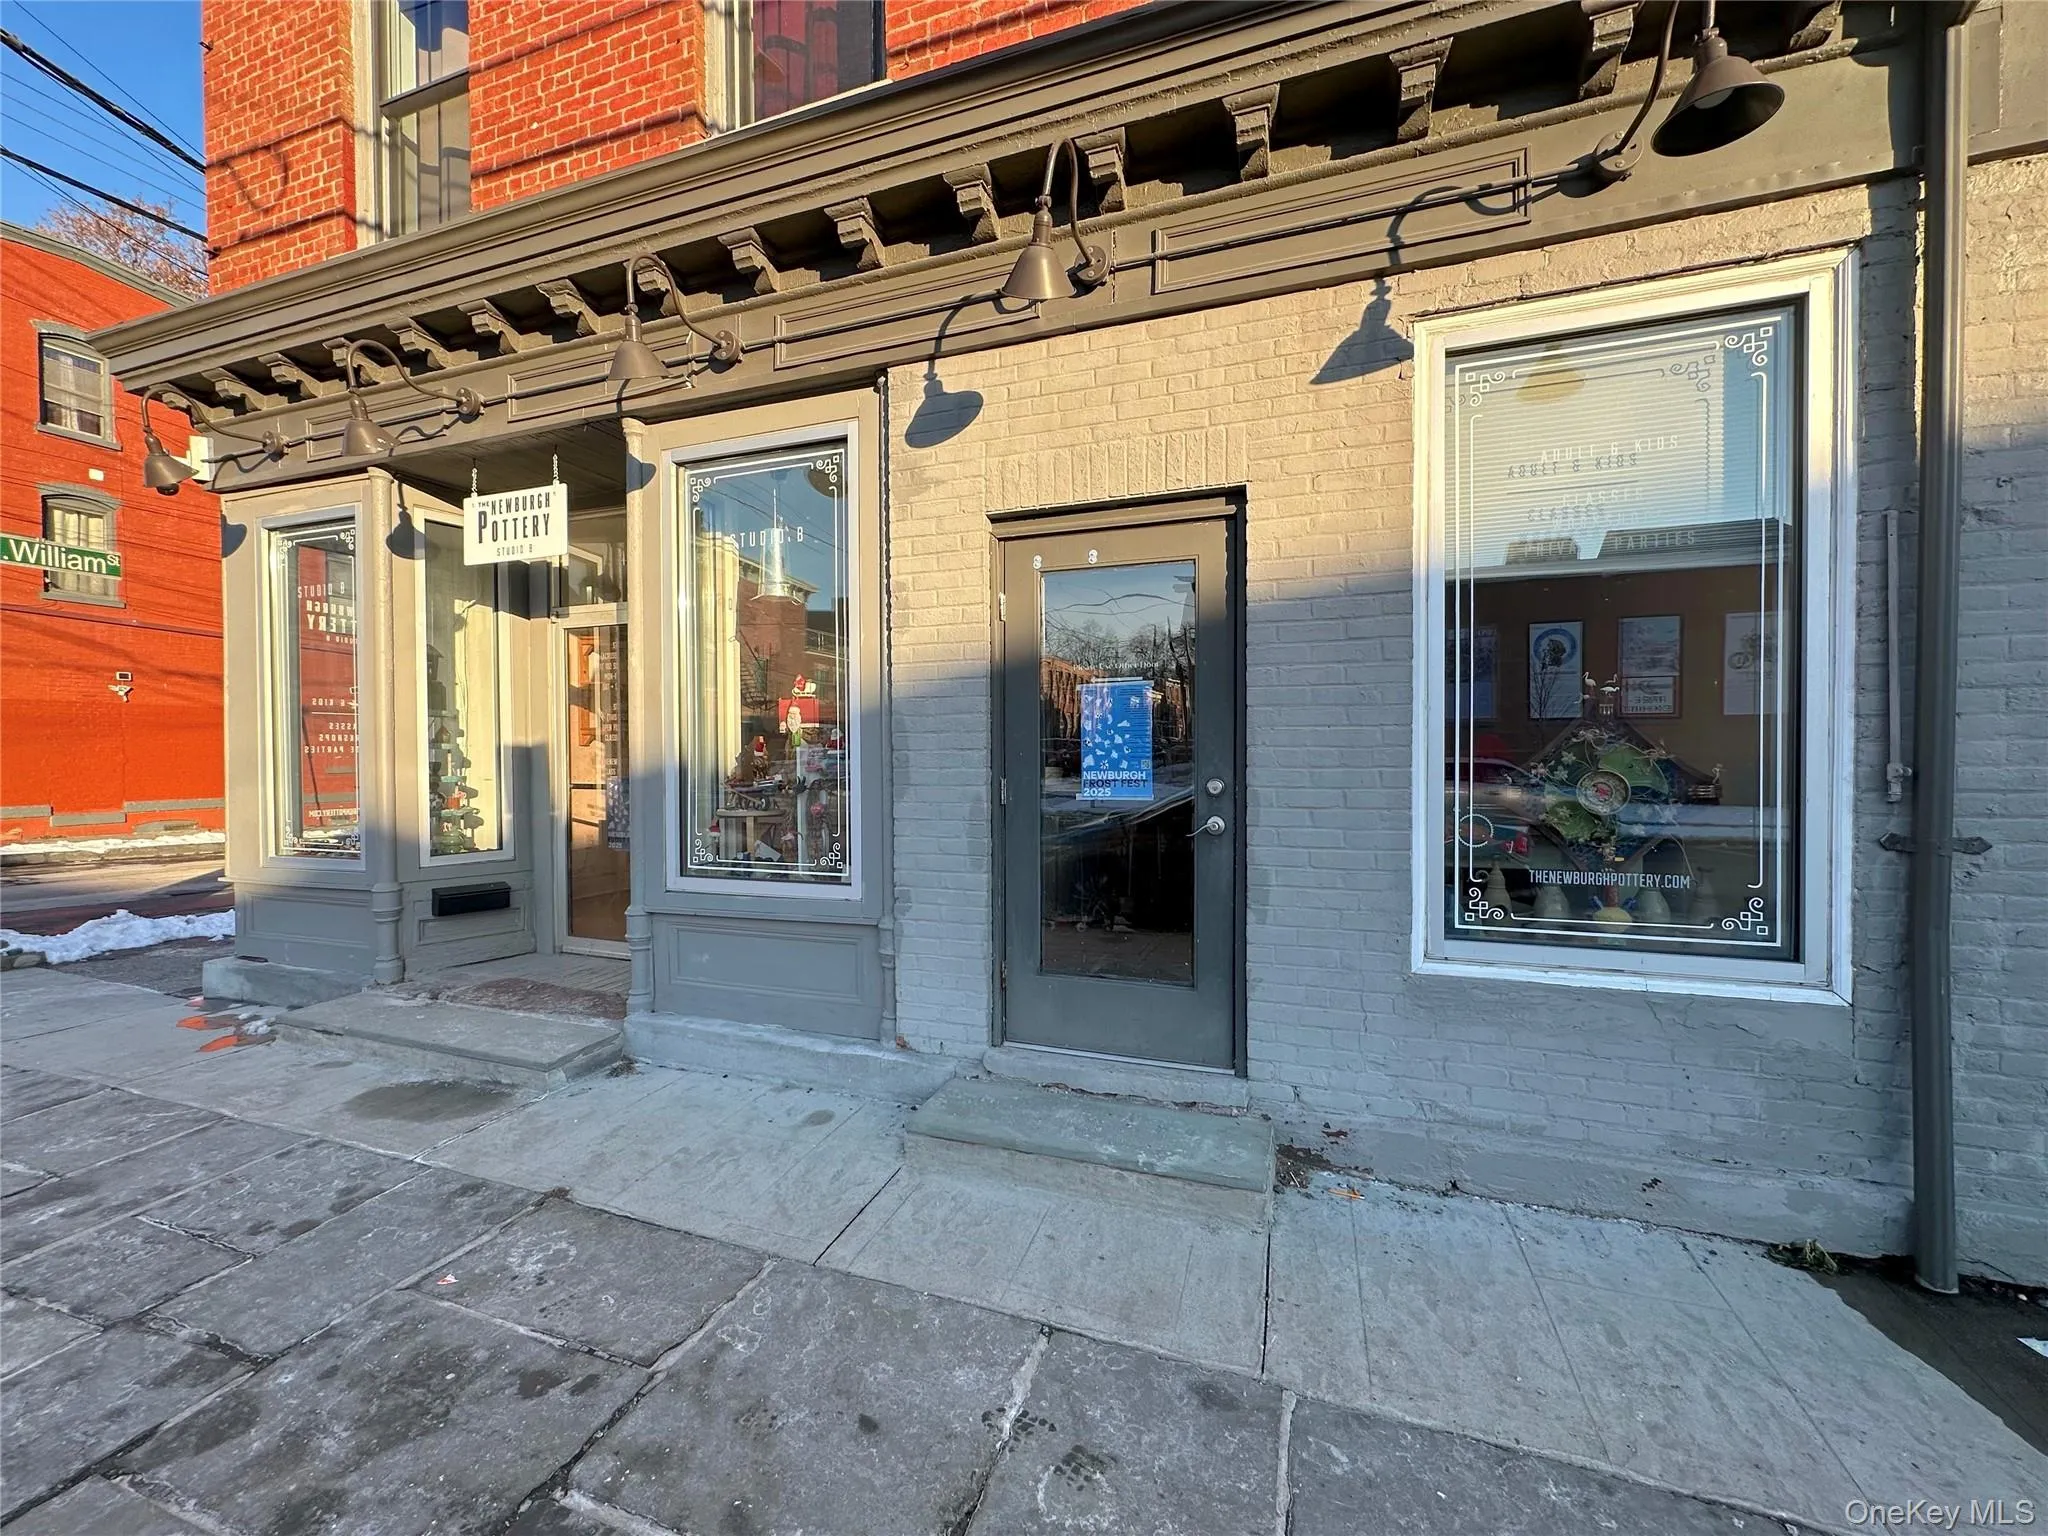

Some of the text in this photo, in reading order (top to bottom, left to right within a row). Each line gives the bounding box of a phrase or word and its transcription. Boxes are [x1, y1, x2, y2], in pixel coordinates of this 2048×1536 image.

[491, 492, 550, 515] NEWBURGH
[478, 511, 550, 544] POTTERY
[797, 526, 804, 542] B
[9, 539, 120, 574] William St
[1083, 770, 1146, 780] NEWBURGH
[1083, 780, 1147, 788] FROST FEST
[1083, 788, 1112, 797] 2025
[1529, 869, 1690, 889] THENEWBURGHPOTTERY.COM
